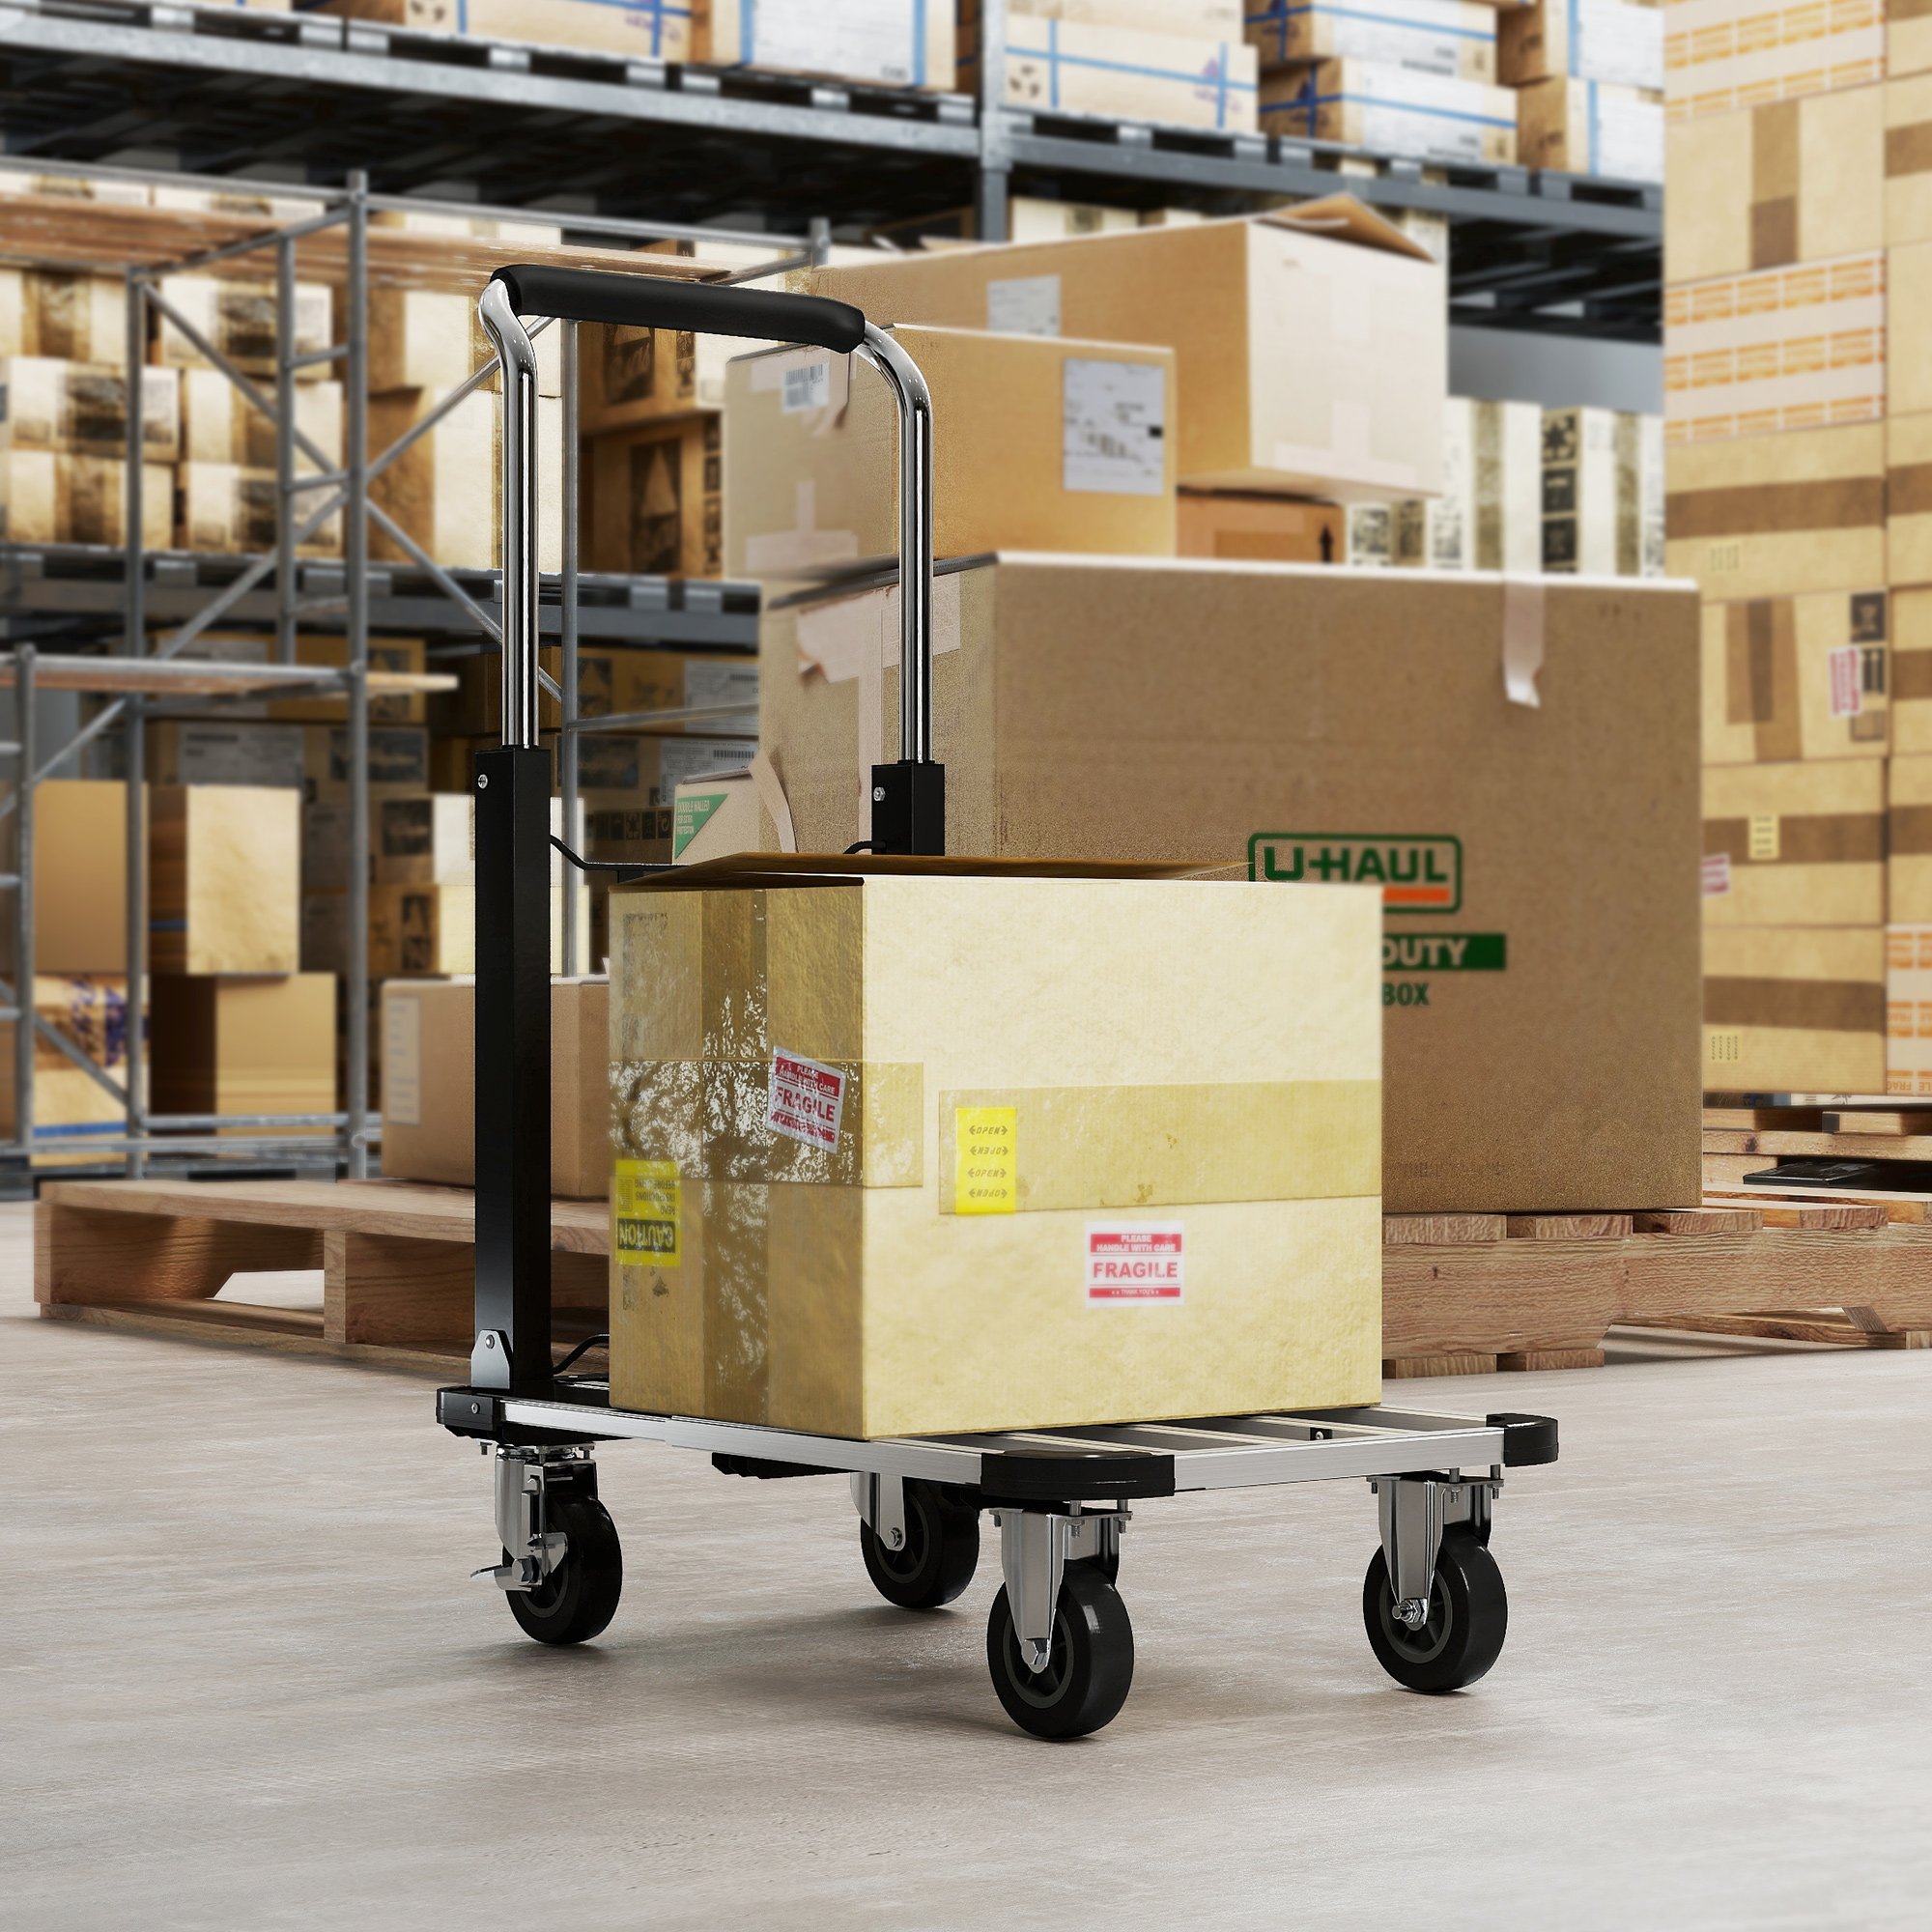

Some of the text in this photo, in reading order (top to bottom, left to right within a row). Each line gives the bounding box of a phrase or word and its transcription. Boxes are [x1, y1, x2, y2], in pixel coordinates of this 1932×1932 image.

[677, 801, 694, 813] DOUBLE
[1382, 938, 1469, 966] DUTY
[1381, 982, 1430, 1006] BOX
[779, 1068, 803, 1083] HANDLE
[818, 1082, 836, 1094] CARE
[775, 1086, 837, 1122] FRAGILE
[976, 1126, 1001, 1135] OPEN
[975, 1169, 1000, 1178] OPEN
[635, 1179, 675, 1190] BEFORE ING
[636, 1191, 675, 1202] INSRUCTIONS
[660, 1205, 675, 1215] READ
[619, 1223, 673, 1247] CAUTION
[1121, 1235, 1152, 1243] PLEASE
[1096, 1243, 1177, 1252] HANDLE WITH CARE
[1093, 1262, 1179, 1278] FRAGILE
